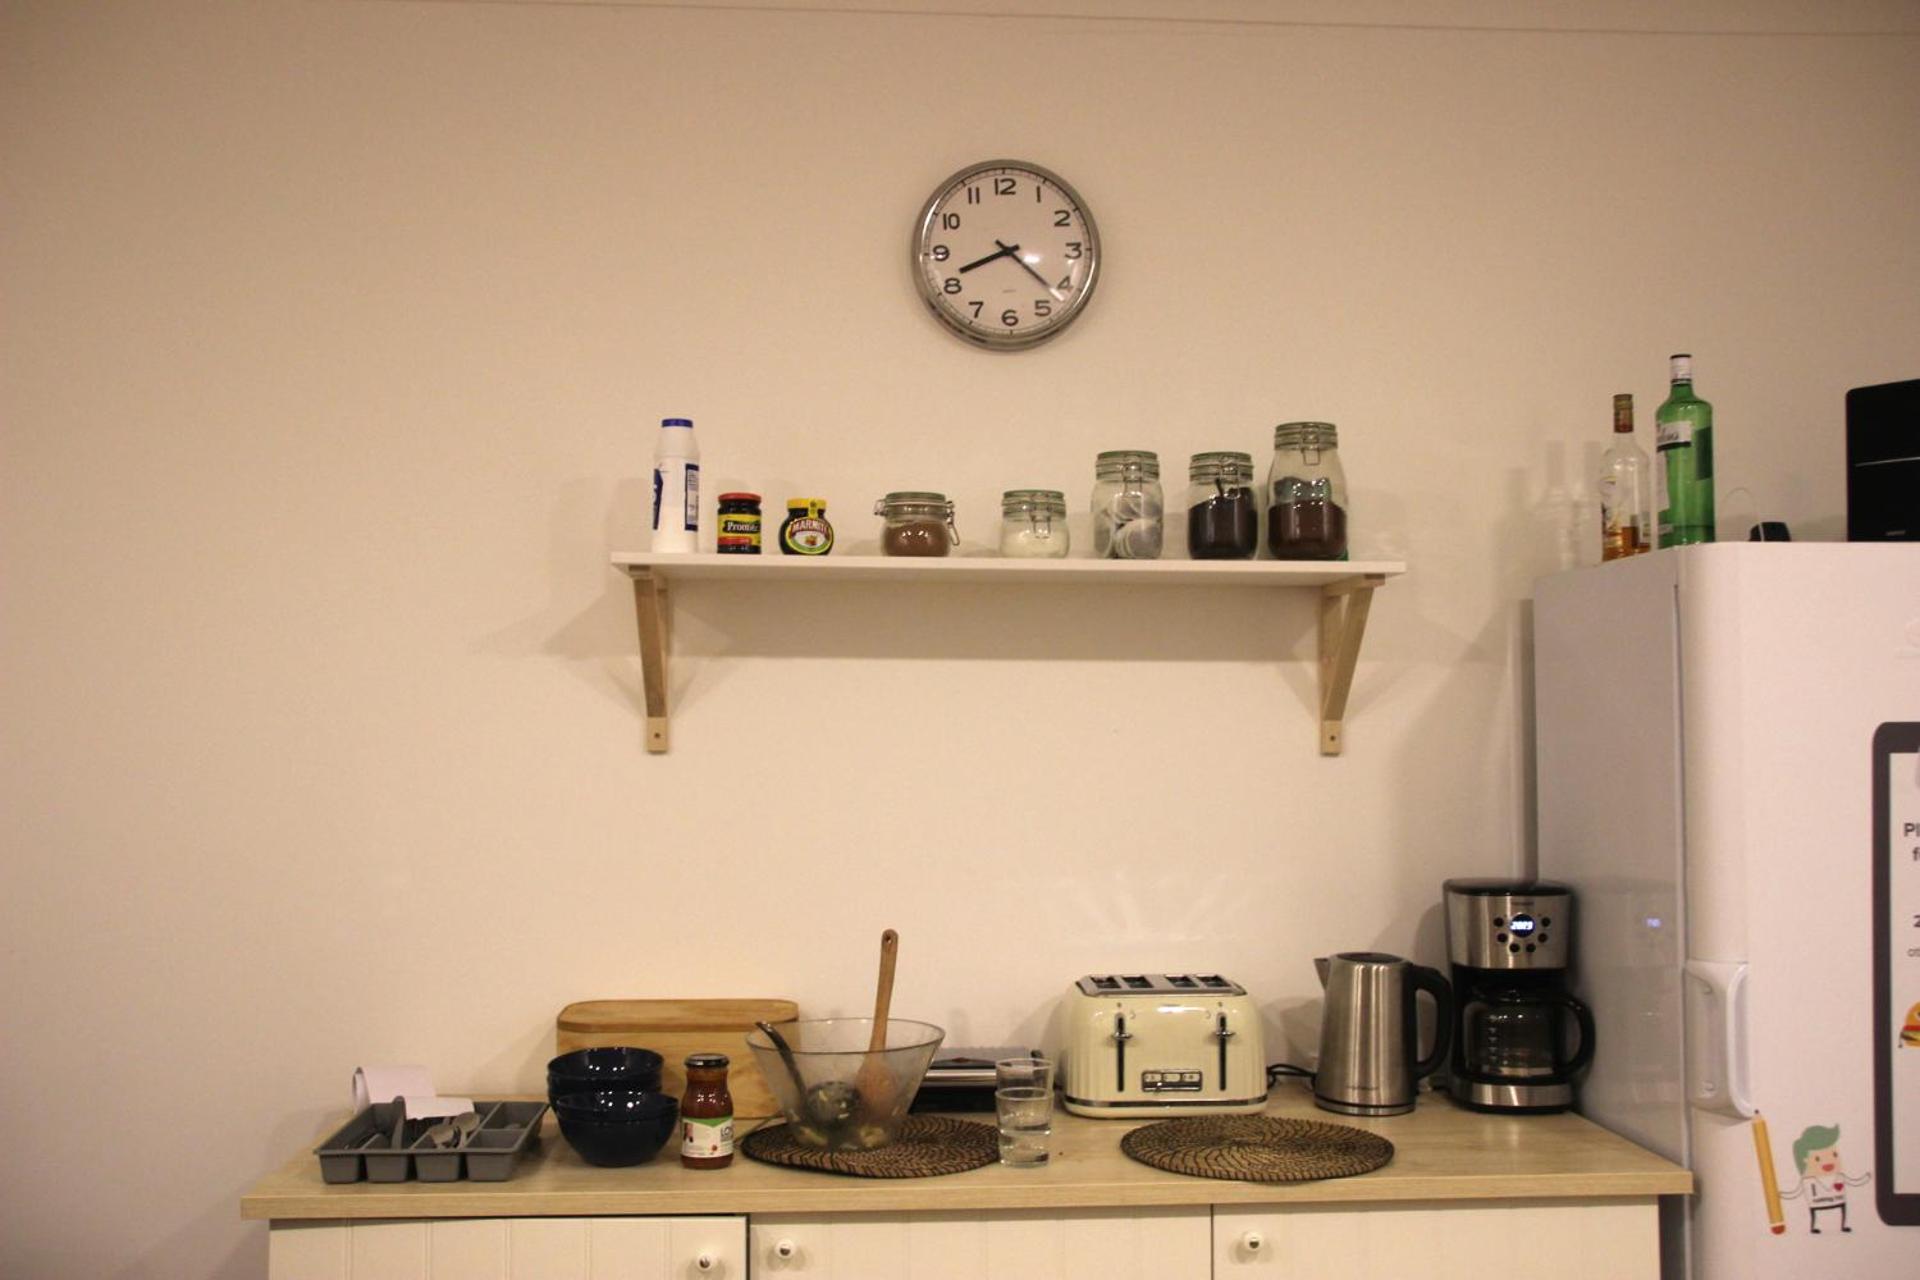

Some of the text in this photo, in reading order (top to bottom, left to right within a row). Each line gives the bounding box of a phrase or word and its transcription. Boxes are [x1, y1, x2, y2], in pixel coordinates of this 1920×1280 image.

[968, 187, 980, 204] 11
[994, 178, 1017, 195] 12
[1036, 185, 1042, 203] 1
[942, 212, 960, 230] 10
[1054, 210, 1071, 227] 2
[932, 244, 950, 262] 9
[1065, 242, 1082, 260] 3
[943, 277, 962, 295] 8
[1056, 275, 1073, 292] 4
[968, 301, 984, 319] 7
[1034, 300, 1051, 317] 5
[1001, 309, 1019, 327] 6
